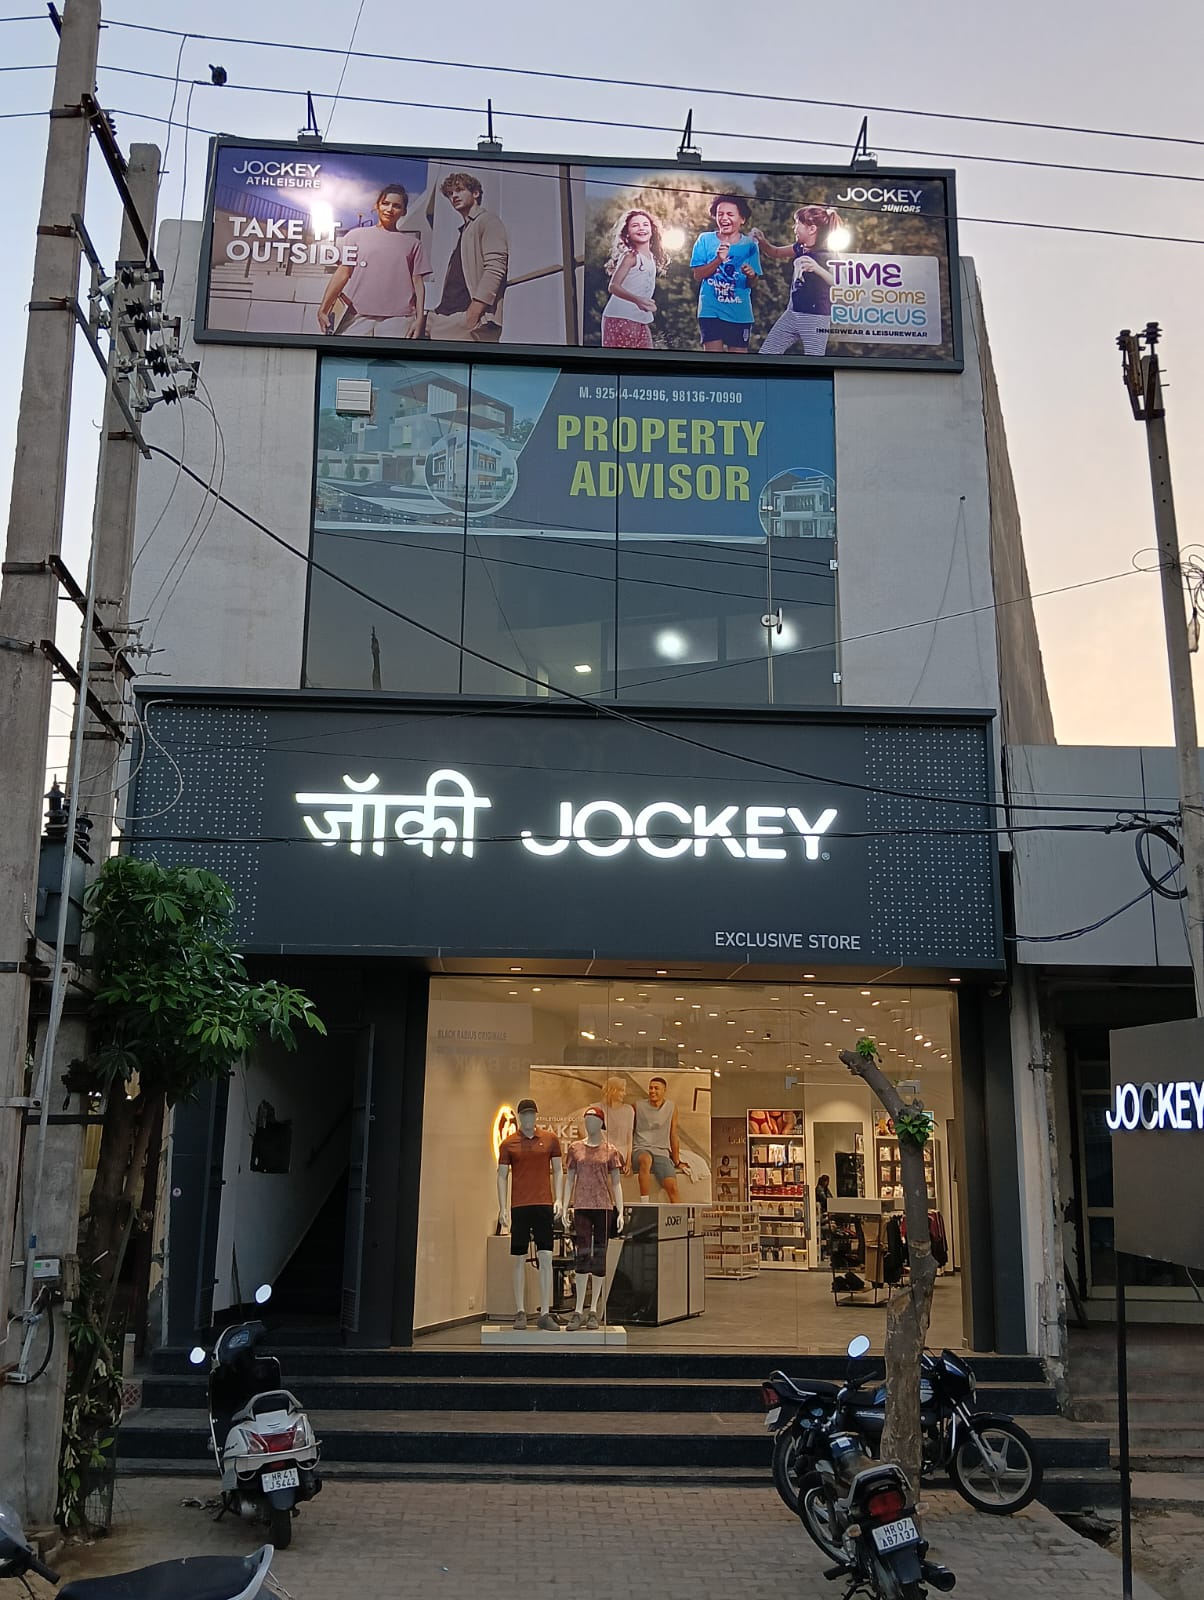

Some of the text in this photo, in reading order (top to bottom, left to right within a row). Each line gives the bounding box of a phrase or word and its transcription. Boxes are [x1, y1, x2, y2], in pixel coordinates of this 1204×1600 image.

[233, 161, 321, 177] JOCKEY
[246, 176, 320, 188] ATHLEISURE
[837, 187, 922, 202] JOCKEY
[229, 217, 304, 240] TAKE
[226, 240, 367, 267] OUTSIDE.
[816, 328, 864, 336] INNERWEAR
[872, 330, 928, 338] LEISUREWEAR
[579, 387, 592, 399] M.
[672, 390, 743, 403] 98136-70990
[557, 415, 765, 456] PROPERTY
[569, 461, 750, 501] ADVISOR
[295, 768, 492, 859] जॉकी
[715, 931, 861, 950] EXCLUSIVE STORE
[1105, 1082, 1204, 1130] JOCKEY
[283, 1470, 292, 1479] 41
[883, 1519, 907, 1537] HR 07
